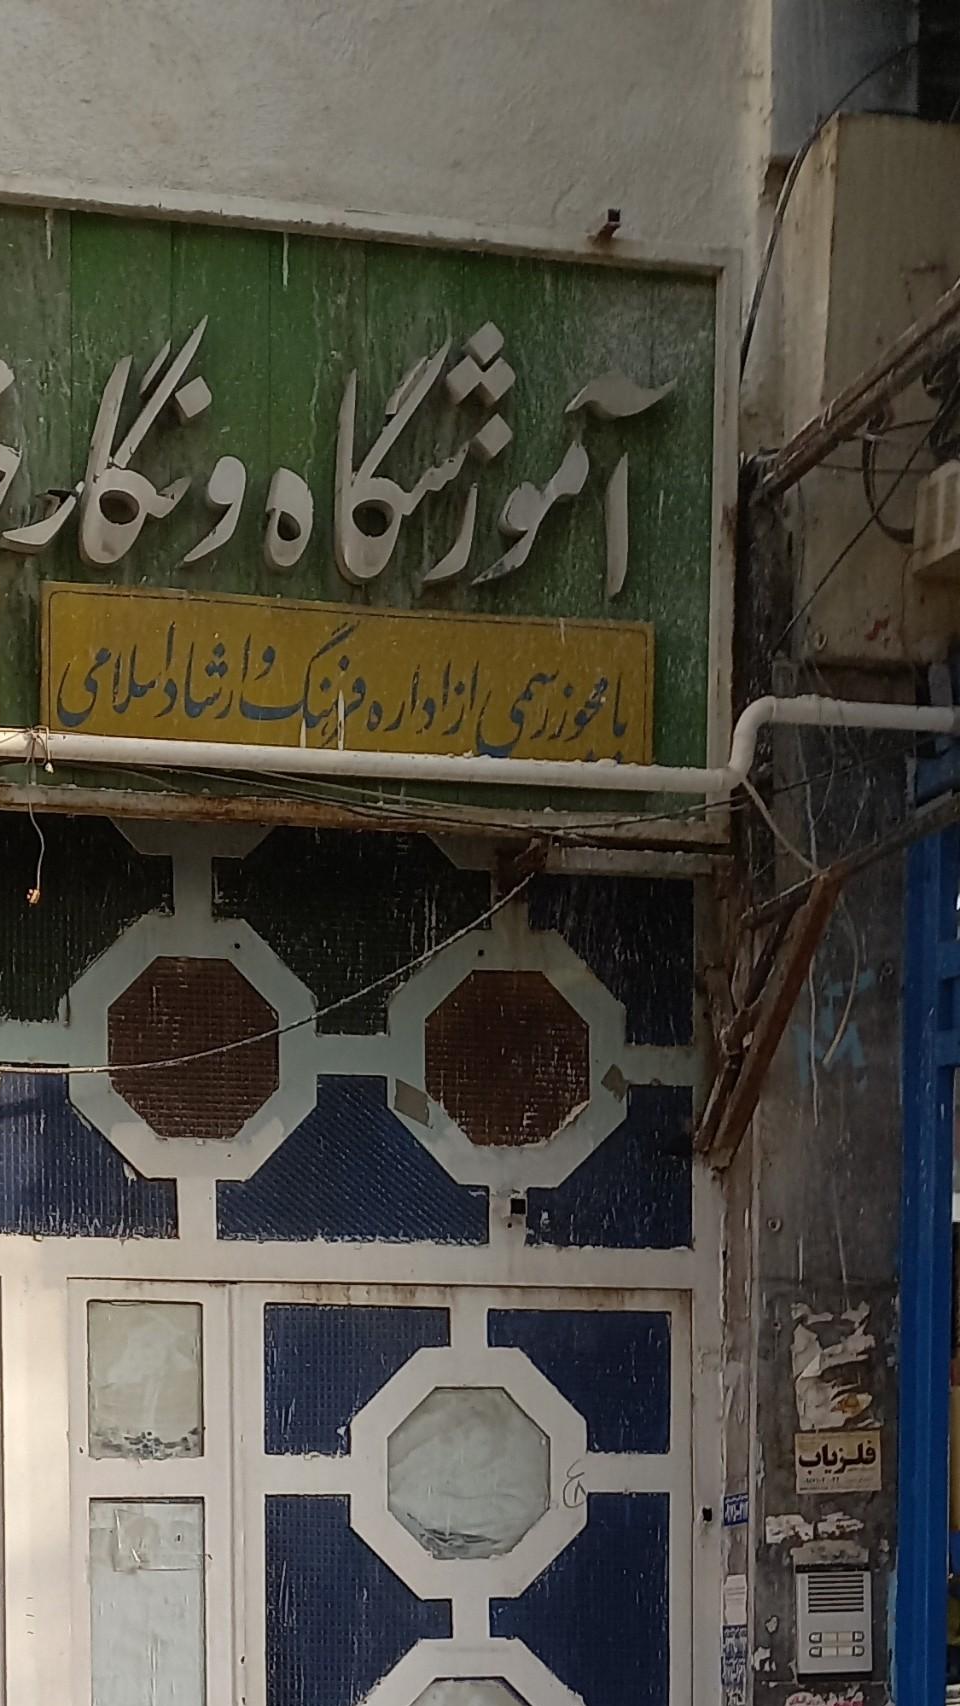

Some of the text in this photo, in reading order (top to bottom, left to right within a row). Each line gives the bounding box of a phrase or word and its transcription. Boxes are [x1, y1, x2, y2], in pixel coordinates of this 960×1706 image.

[266, 321, 677, 598] آموزشگاه
[56, 620, 176, 727] اسلامی
[153, 633, 252, 719] ارشاد
[476, 668, 560, 758] رسمی
[798, 1439, 877, 1476] فلزیاب
